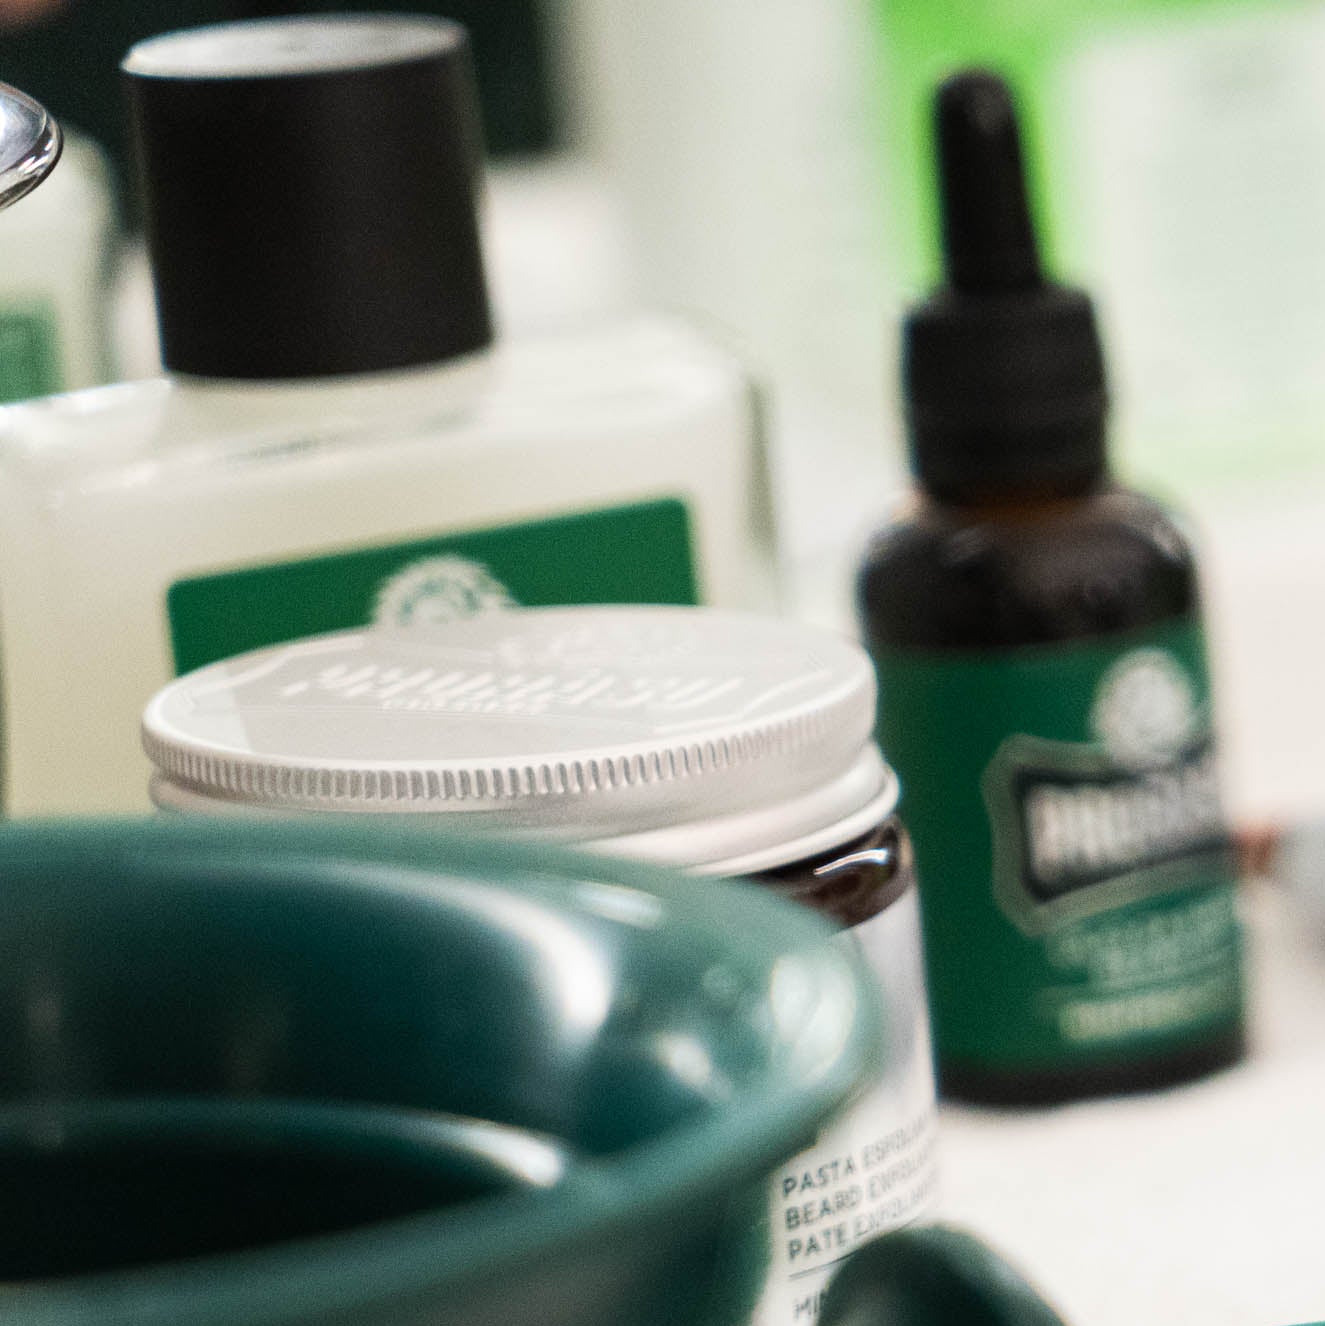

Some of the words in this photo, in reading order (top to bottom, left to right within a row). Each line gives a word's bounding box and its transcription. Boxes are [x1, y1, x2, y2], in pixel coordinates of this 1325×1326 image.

[782, 1156, 857, 1198] PASTA
[785, 1184, 863, 1231] BEARD
[788, 1221, 850, 1261] PATE
